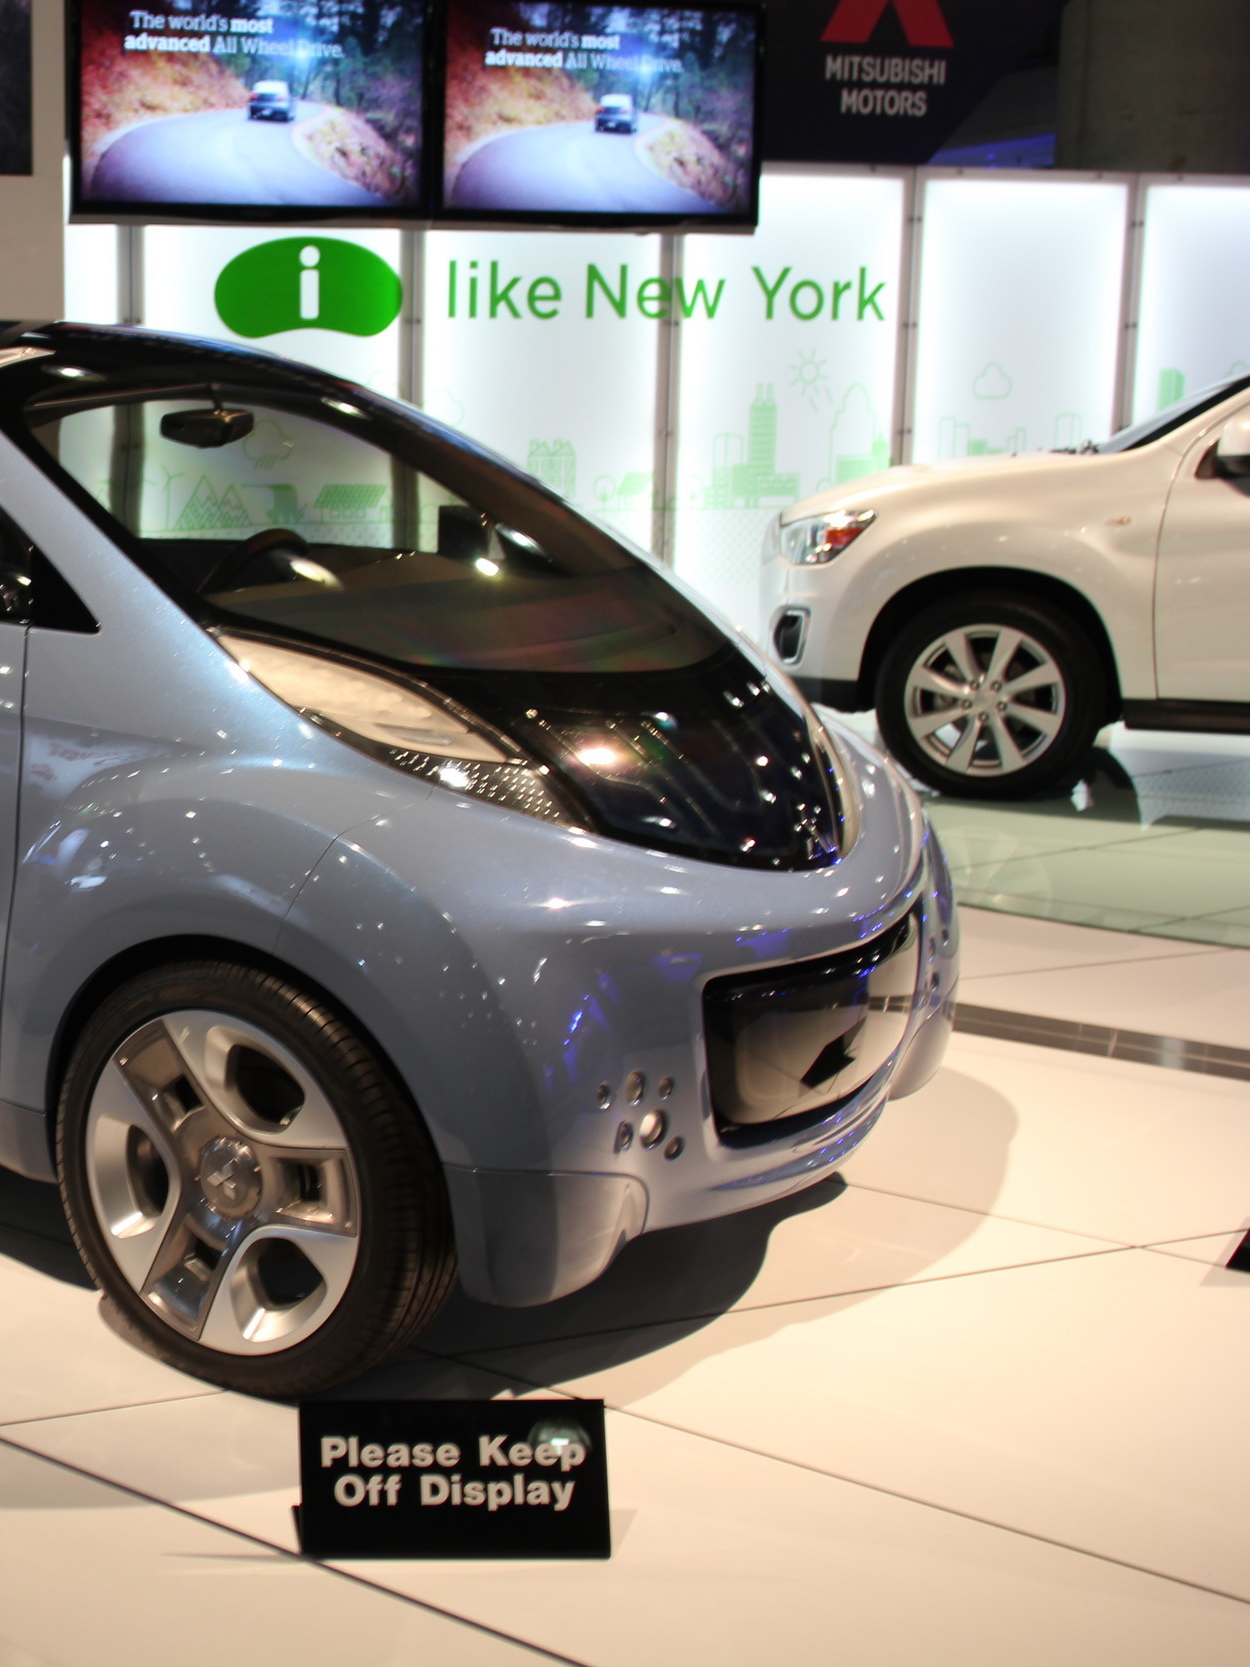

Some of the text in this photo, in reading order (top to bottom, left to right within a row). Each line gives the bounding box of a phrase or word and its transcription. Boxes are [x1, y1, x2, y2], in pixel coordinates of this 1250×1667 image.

[130, 9, 273, 34] The world's most
[124, 32, 211, 52] advanced
[213, 36, 238, 54] All
[241, 37, 293, 56] Wheel
[490, 27, 620, 50] The world's most
[485, 48, 563, 68] advanced
[565, 52, 588, 70] All
[825, 54, 947, 85] MITSUBISHI
[840, 87, 928, 117] MOTORS
[448, 260, 562, 319] like
[586, 264, 725, 319] New
[752, 266, 886, 321] York
[320, 1434, 587, 1472] Please Keep
[334, 1473, 576, 1512] Off Display
